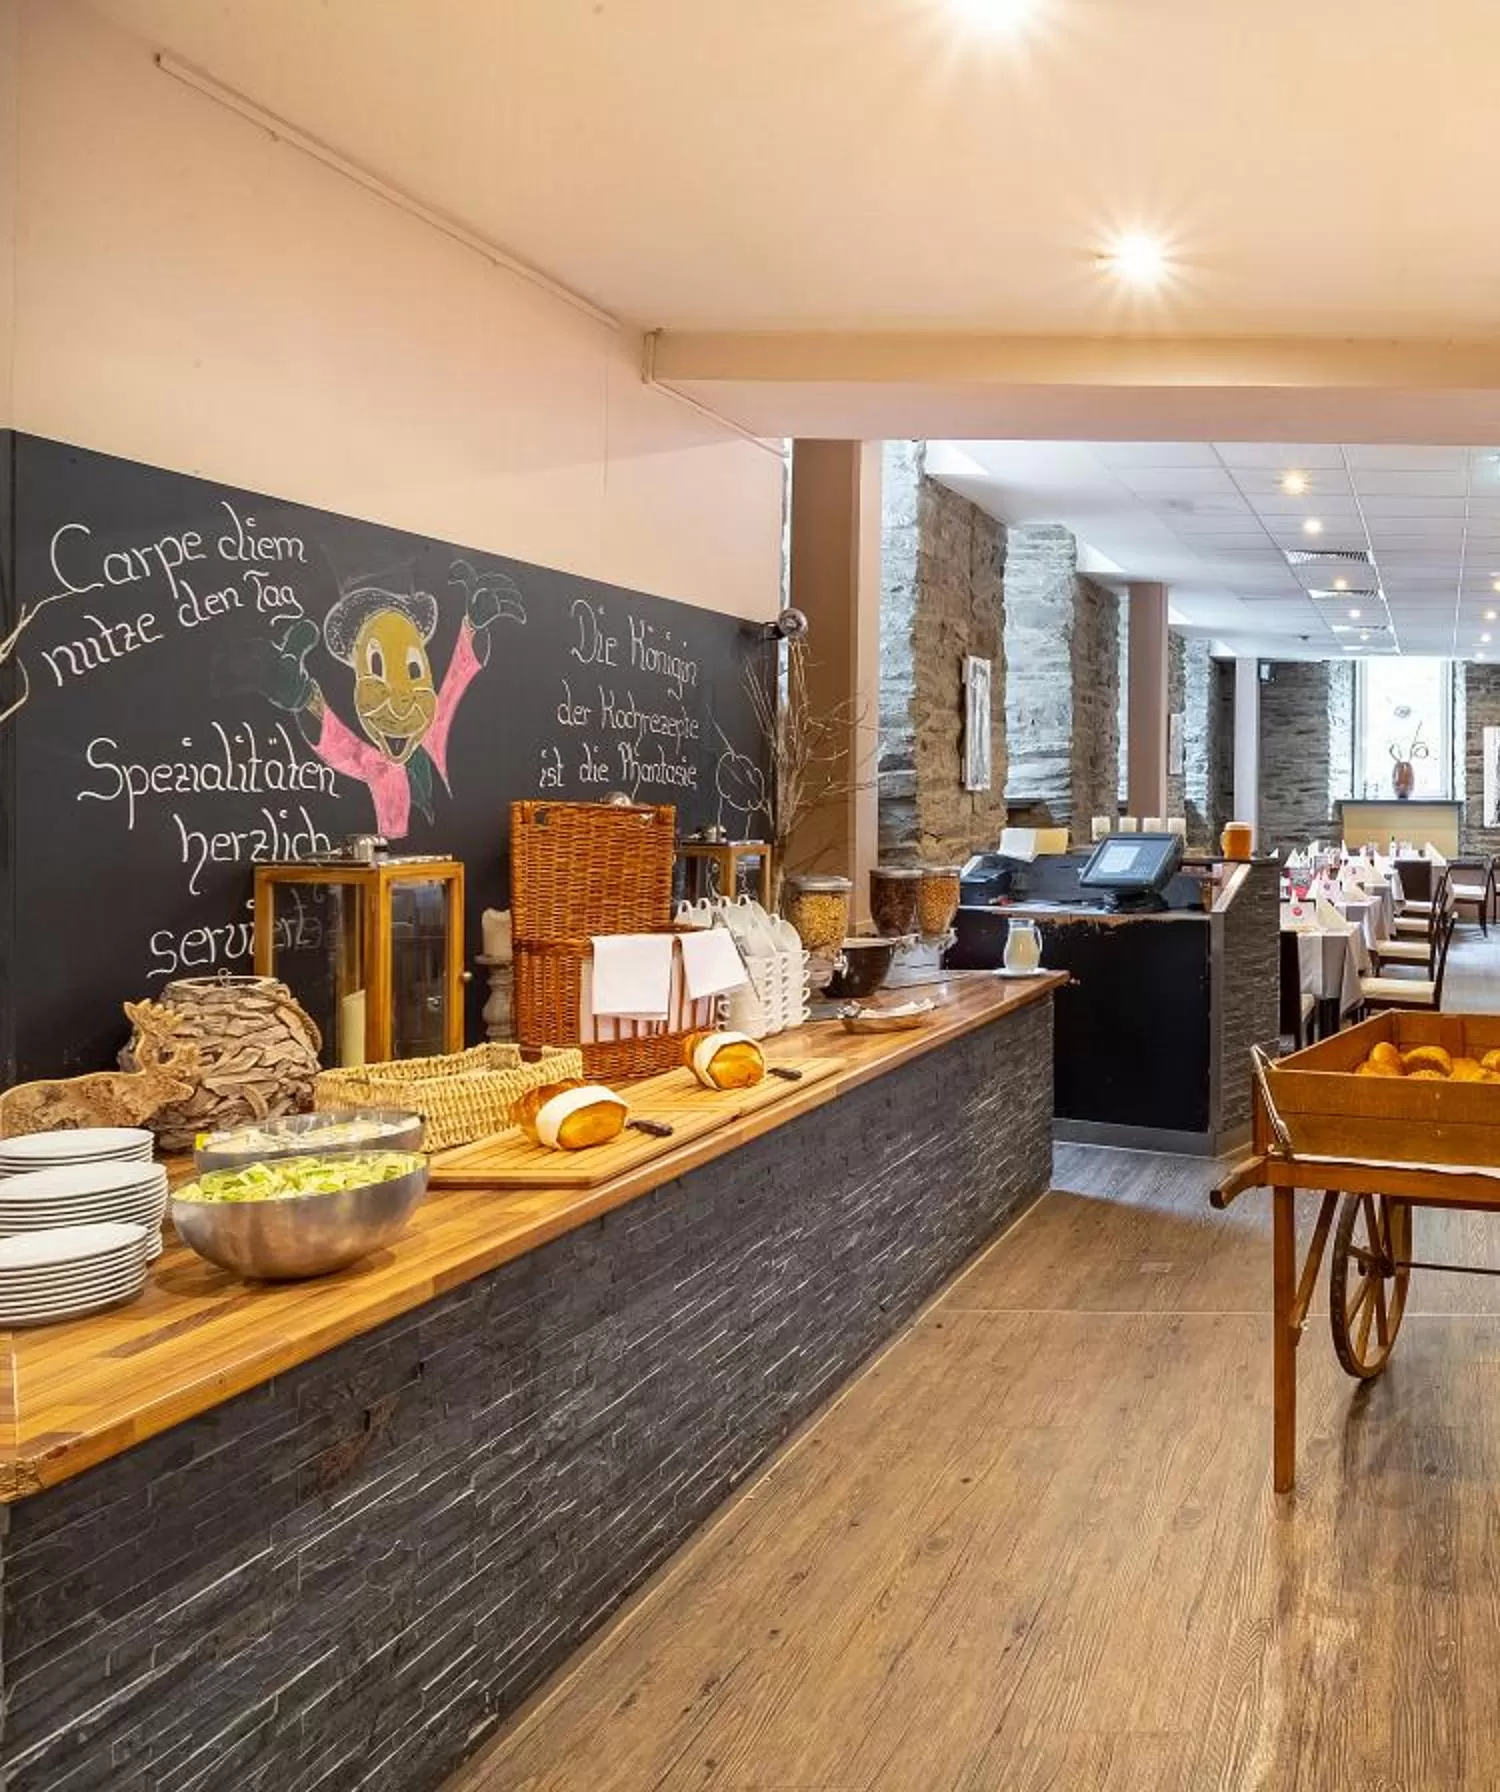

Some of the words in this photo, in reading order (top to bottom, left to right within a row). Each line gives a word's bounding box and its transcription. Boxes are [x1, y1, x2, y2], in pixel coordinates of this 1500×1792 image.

[50, 523, 203, 601] Carpe
[218, 502, 307, 563] diem
[42, 612, 163, 687] nutze
[179, 579, 243, 628] den
[243, 570, 304, 627] Tag
[571, 599, 617, 667] Die
[628, 614, 697, 701] Königin
[557, 678, 592, 727] der
[598, 684, 700, 756] Kochrezepte
[77, 722, 340, 830] Spezialitäten
[539, 746, 566, 788] ist
[579, 742, 609, 782] die
[617, 741, 698, 799] Phantasie
[172, 806, 332, 895] herzlich
